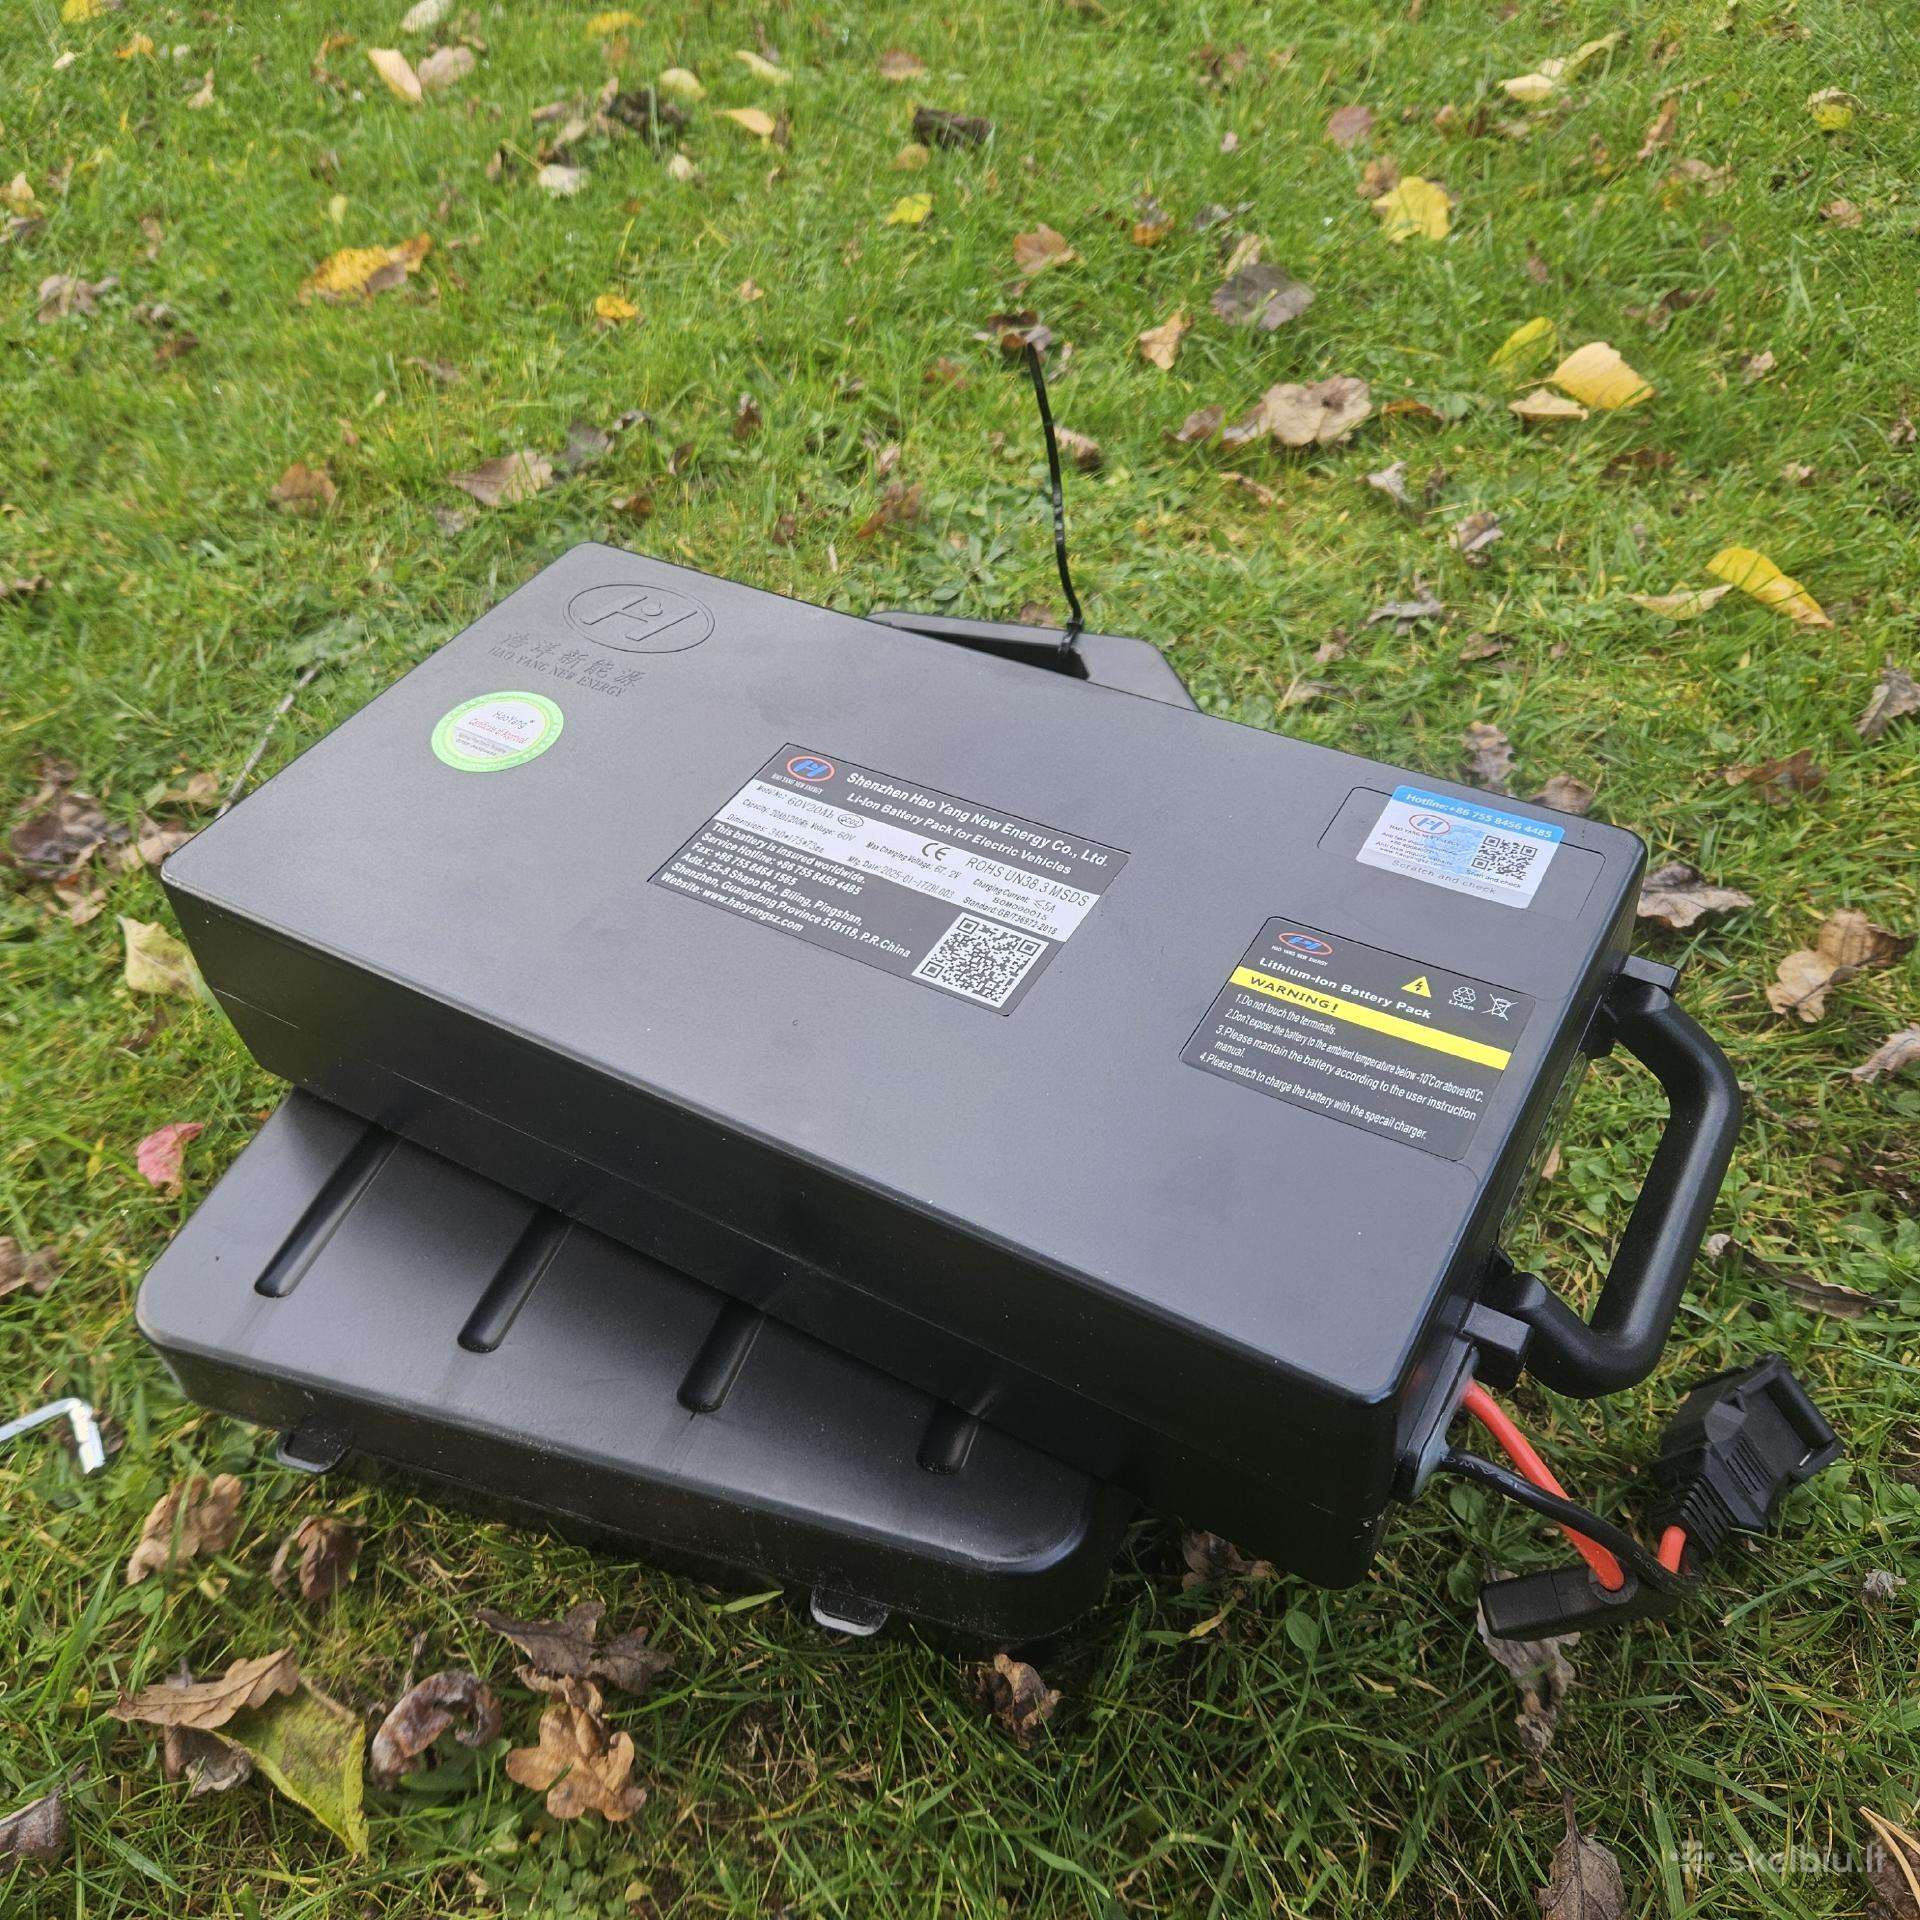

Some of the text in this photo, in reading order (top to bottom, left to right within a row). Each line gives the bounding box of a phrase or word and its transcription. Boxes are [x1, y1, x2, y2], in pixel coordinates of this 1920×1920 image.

[516, 655, 550, 672] YANG
[549, 666, 577, 680] NEW
[576, 675, 629, 697] ENERGY
[785, 795, 837, 819] 60V20Ah
[846, 772, 1107, 866] Shenzhen Hao Yang New Energy Co., Ltd.
[1470, 810, 1493, 822] 755
[1493, 816, 1523, 830] 8456
[1523, 824, 1553, 838] 4485
[712, 821, 865, 883] This battery is insured worldwide.
[835, 830, 857, 842] 60V
[880, 804, 923, 824] Battery
[923, 817, 953, 834] Pack
[952, 828, 972, 840] for
[971, 834, 1018, 856] Electric
[1020, 849, 1071, 874] Vehicles
[691, 841, 798, 885] Fax: +86 755 8464 1565
[701, 832, 862, 894] Service Hotline: +86 755 8456 4485
[965, 856, 1089, 906] ROHS UN38.3 MSDS
[1391, 859, 1435, 876] Scratch
[1437, 873, 1459, 884] and
[1461, 880, 1497, 895] check
[1499, 878, 1521, 888] check
[660, 871, 803, 931] Website: www.haoyangsz.com
[671, 862, 910, 957] Shenzhen, Guangdong Province 518118, P.R.China
[706, 861, 731, 875] 25-8
[728, 869, 760, 886] Shapo
[779, 888, 811, 907] Biling,
[813, 899, 861, 926] Pingshan,
[970, 877, 1005, 895] Charging
[1001, 888, 1032, 904] Current:
[1235, 993, 1335, 1035] 1.Do not touch the terminals.
[1340, 983, 1392, 1006] Battery
[1395, 1001, 1431, 1018] Pack
[1214, 1040, 1245, 1057] manual.
[1215, 1024, 1476, 1120] 3.Please mantain the battery according to the user instruction
[1248, 1018, 1273, 1031] expose
[1272, 1024, 1287, 1036] the
[1283, 1027, 1308, 1045] battery
[1306, 1036, 1315, 1046] to
[1314, 1038, 1327, 1050] the
[1325, 1044, 1354, 1059] ambient
[1353, 1051, 1395, 1073] temperature
[1394, 1065, 1416, 1080] below
[1199, 1051, 1426, 1139] 4.Please match to charge the battery with the specail charger.
